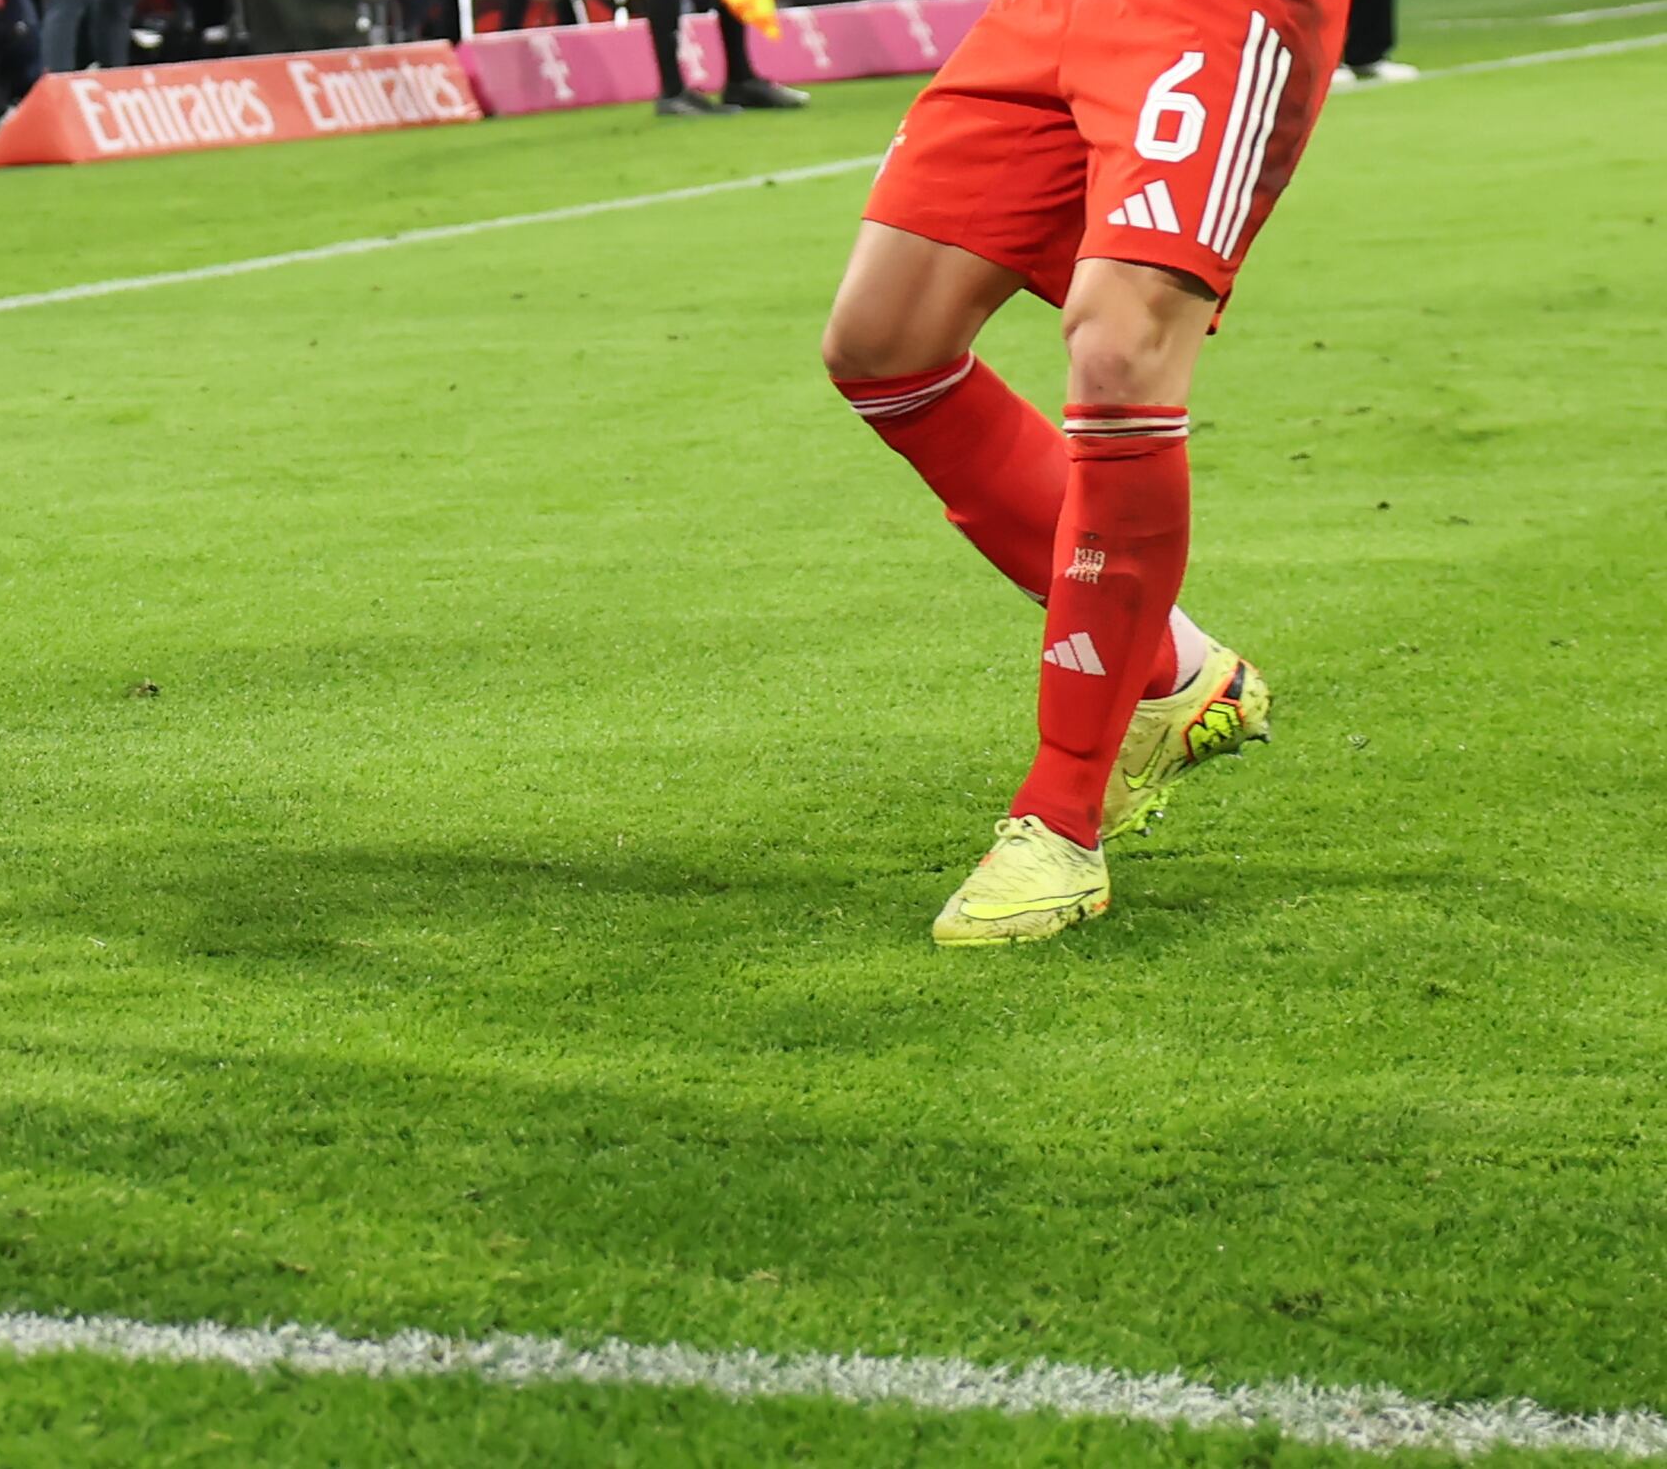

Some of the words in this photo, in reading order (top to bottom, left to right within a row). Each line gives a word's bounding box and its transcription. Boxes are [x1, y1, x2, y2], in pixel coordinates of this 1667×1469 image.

[71, 71, 274, 153] Emirates
[286, 56, 465, 132] Emirates
[1134, 50, 1208, 163] 6
